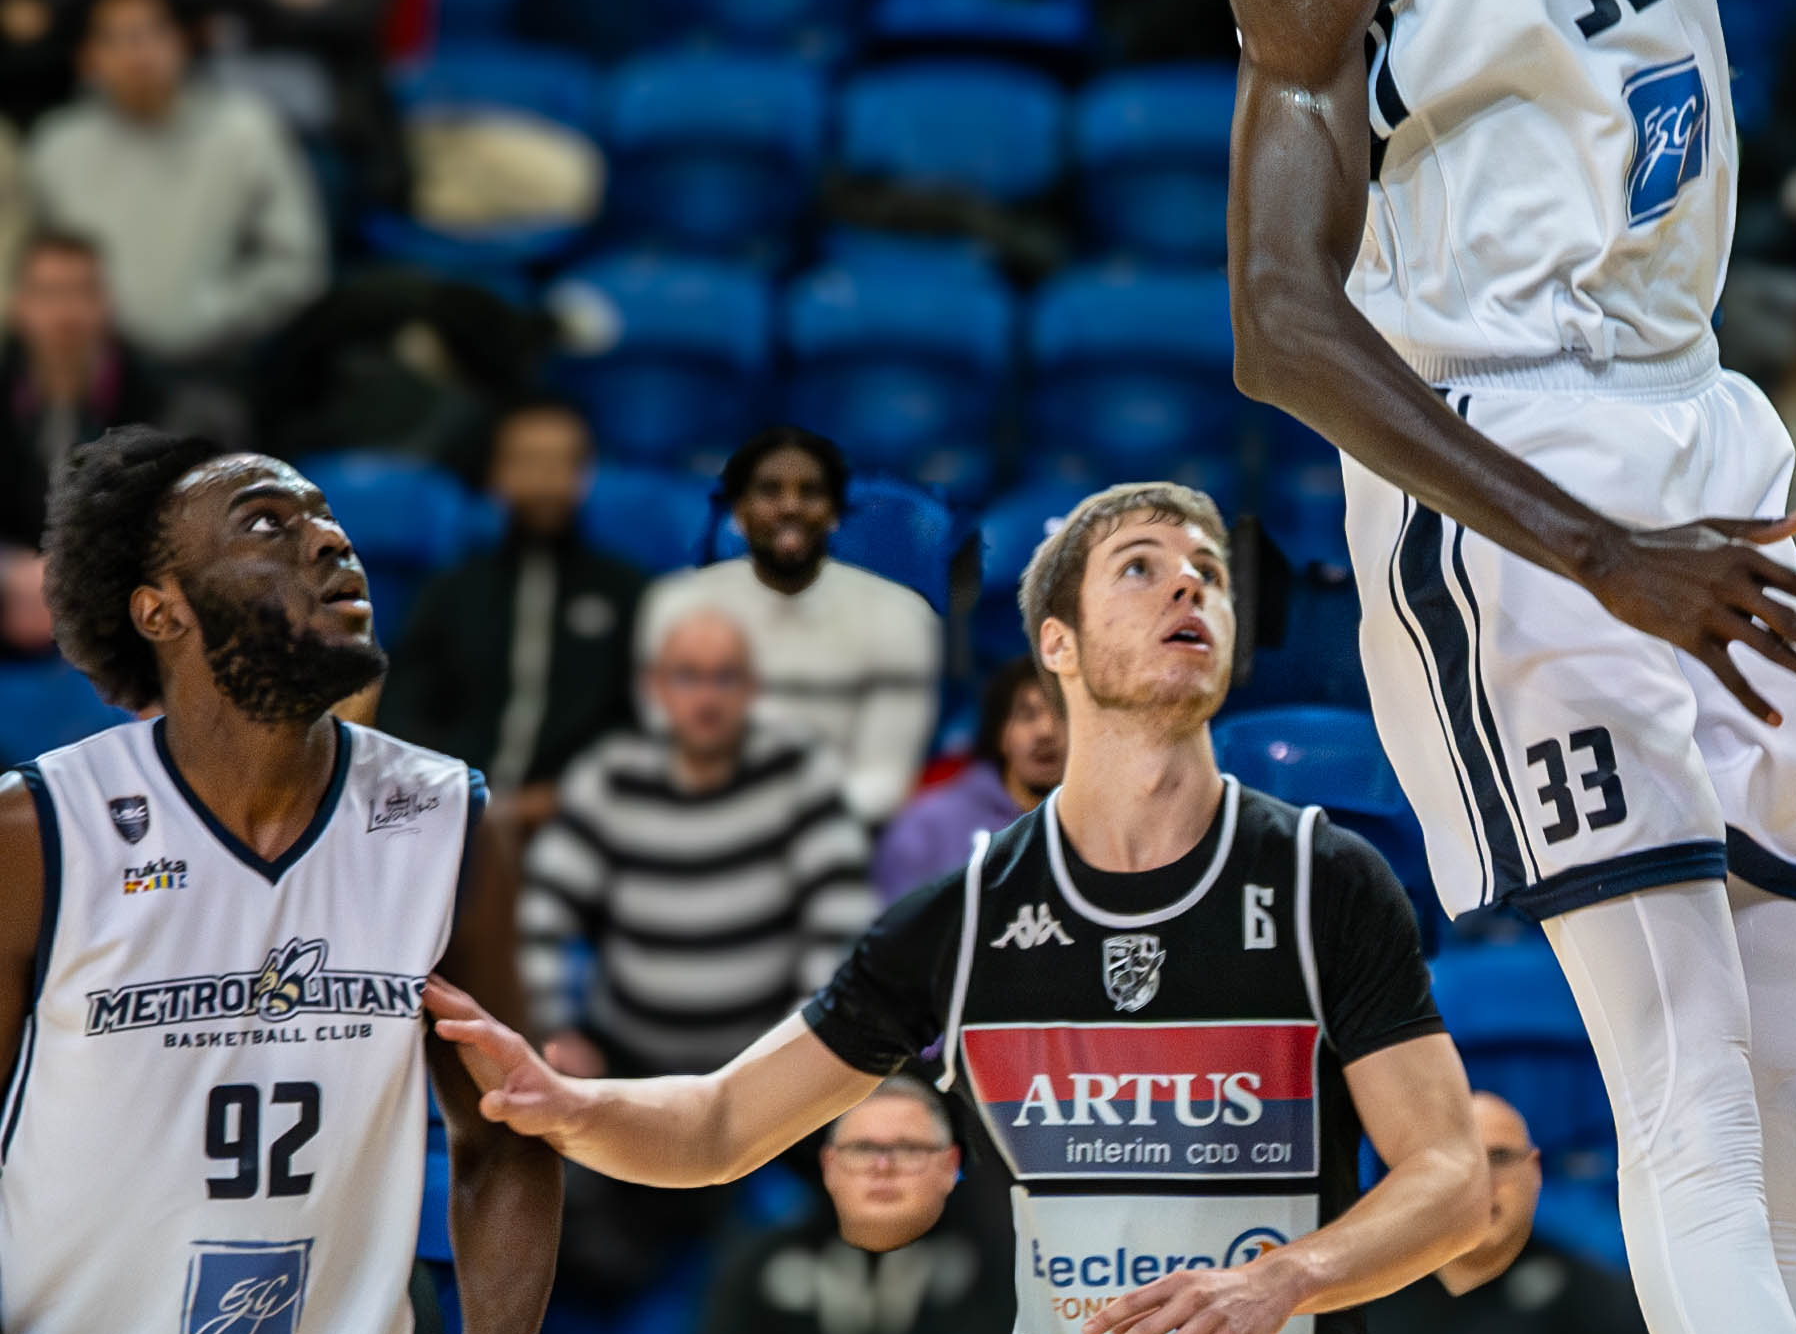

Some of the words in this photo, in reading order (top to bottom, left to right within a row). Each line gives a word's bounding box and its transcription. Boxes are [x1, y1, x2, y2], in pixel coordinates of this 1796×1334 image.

[1527, 726, 1627, 846] 33
[123, 858, 187, 880] rukka
[1243, 884, 1276, 950] 6
[164, 1025, 306, 1049] BASKETBALL
[315, 1022, 373, 1043] CLUB
[1012, 1072, 1264, 1128] ARTUS
[204, 1081, 320, 1199] 92
[1066, 1136, 1171, 1164] interim
[1186, 1142, 1240, 1164] CDD
[1251, 1141, 1292, 1163] CDI
